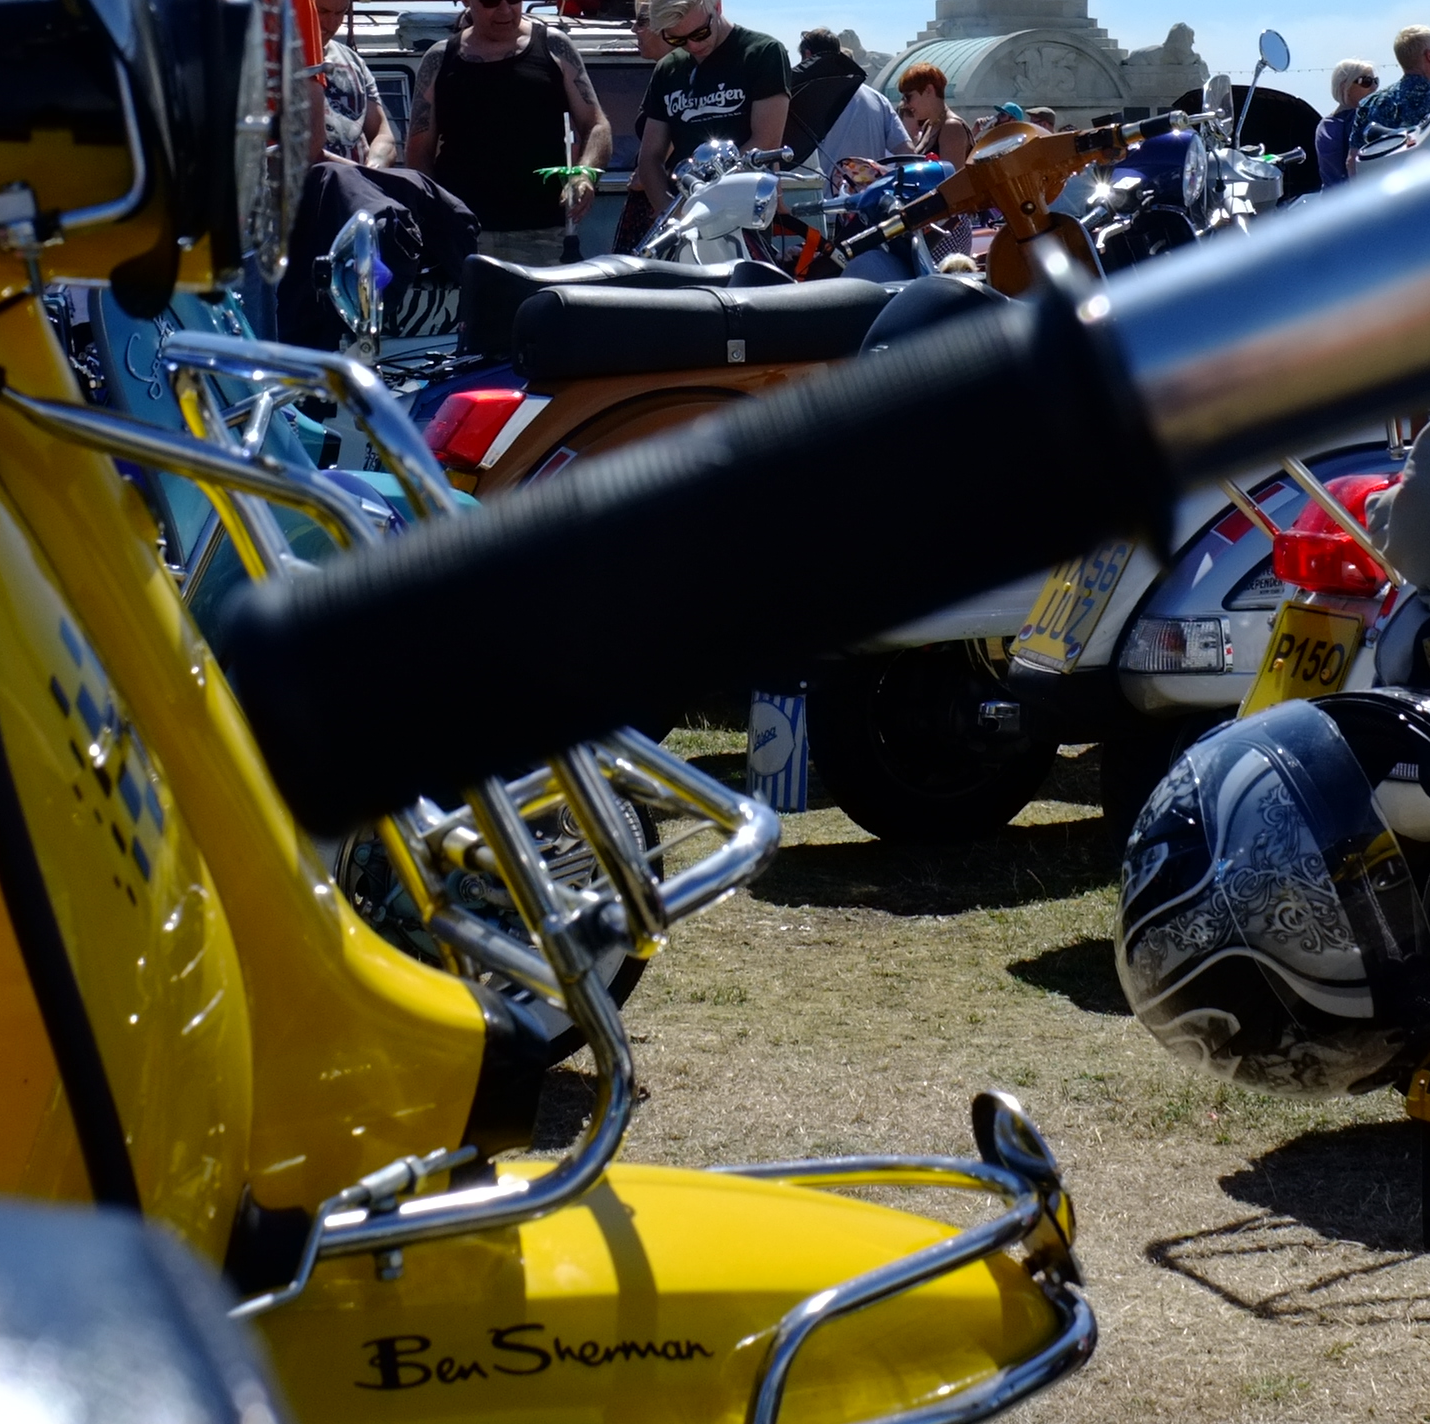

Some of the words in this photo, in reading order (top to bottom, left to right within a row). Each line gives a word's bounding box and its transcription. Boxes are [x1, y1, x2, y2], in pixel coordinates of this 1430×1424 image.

[664, 87, 746, 117] Volkswagen
[354, 1335, 488, 1391] Ben
[487, 1323, 715, 1377] Sherman
